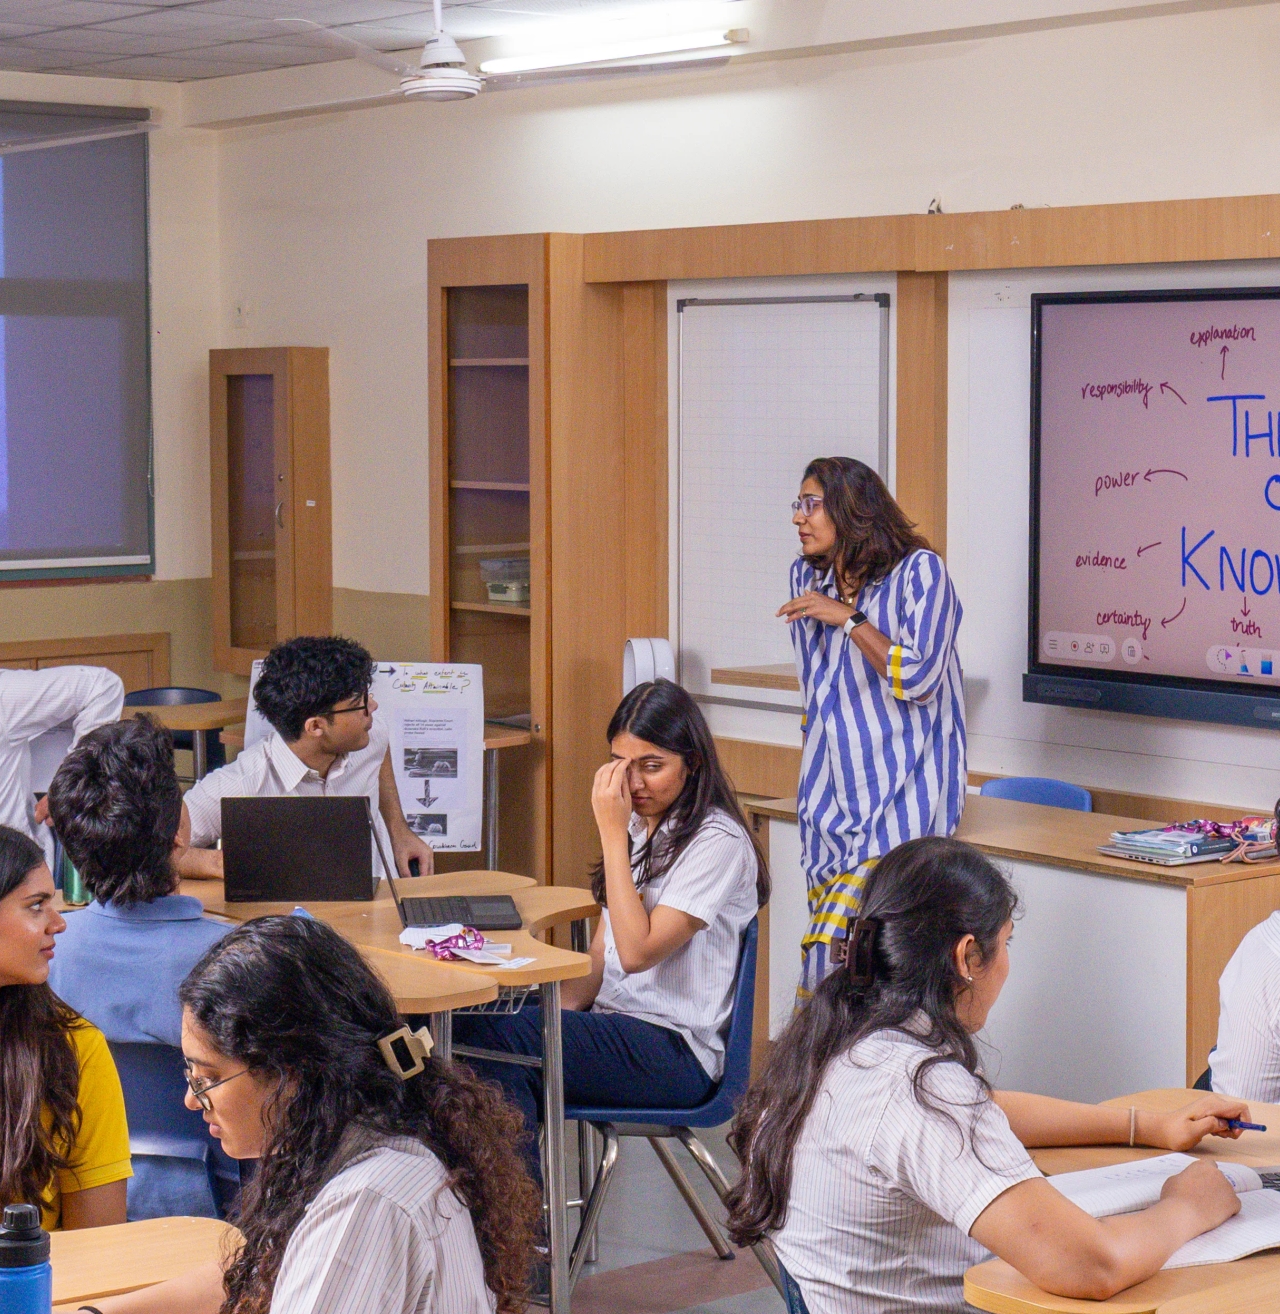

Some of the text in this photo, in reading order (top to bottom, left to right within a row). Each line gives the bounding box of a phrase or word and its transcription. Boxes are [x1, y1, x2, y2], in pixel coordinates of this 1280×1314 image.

[1189, 324, 1257, 348] explanation
[1080, 378, 1154, 410] responsibility
[1094, 471, 1140, 497] power
[1074, 550, 1128, 570] evidence
[1095, 609, 1152, 641] certainty
[1230, 616, 1263, 639] truth
